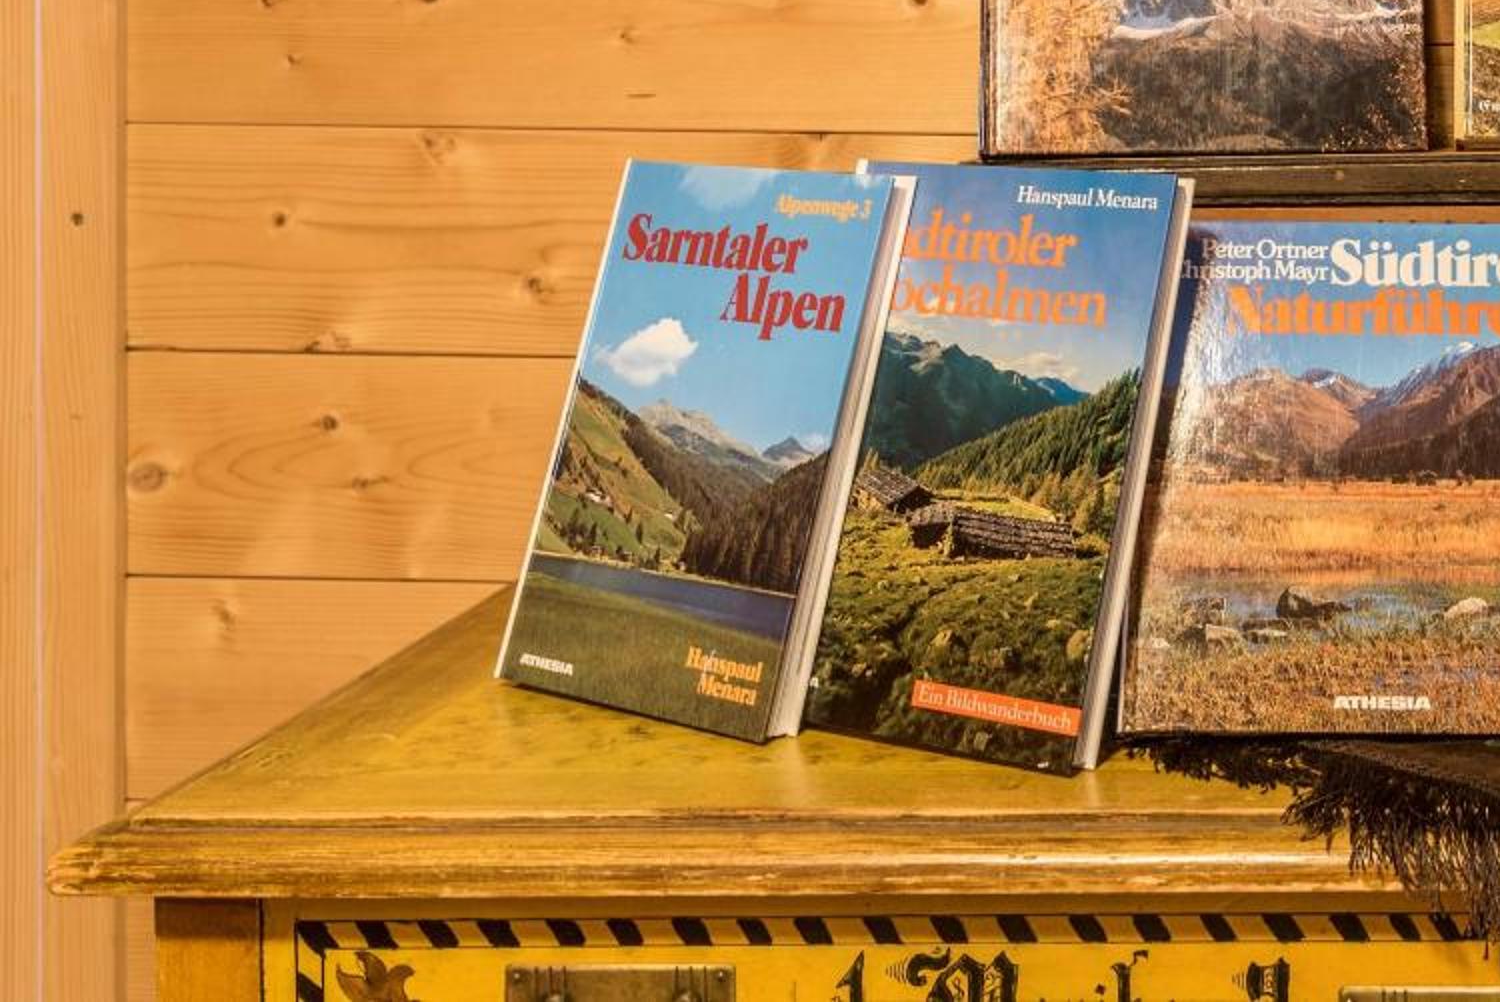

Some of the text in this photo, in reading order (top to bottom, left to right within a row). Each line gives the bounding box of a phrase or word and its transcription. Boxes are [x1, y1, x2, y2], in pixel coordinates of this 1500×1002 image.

[1016, 185, 1159, 210] Hanspaul Menara
[623, 213, 808, 274] Sarntaler
[1202, 239, 1256, 259] Peter
[1256, 238, 1329, 259] Ortner
[1274, 259, 1330, 285] Mayr
[720, 273, 845, 341] Alpen
[519, 652, 574, 677] ATHESIA
[685, 646, 764, 684] Hanspaul
[697, 673, 757, 706] Menara
[1334, 695, 1431, 711] ATHESIA
[918, 685, 1072, 729] Ein Bildwanderbuch
